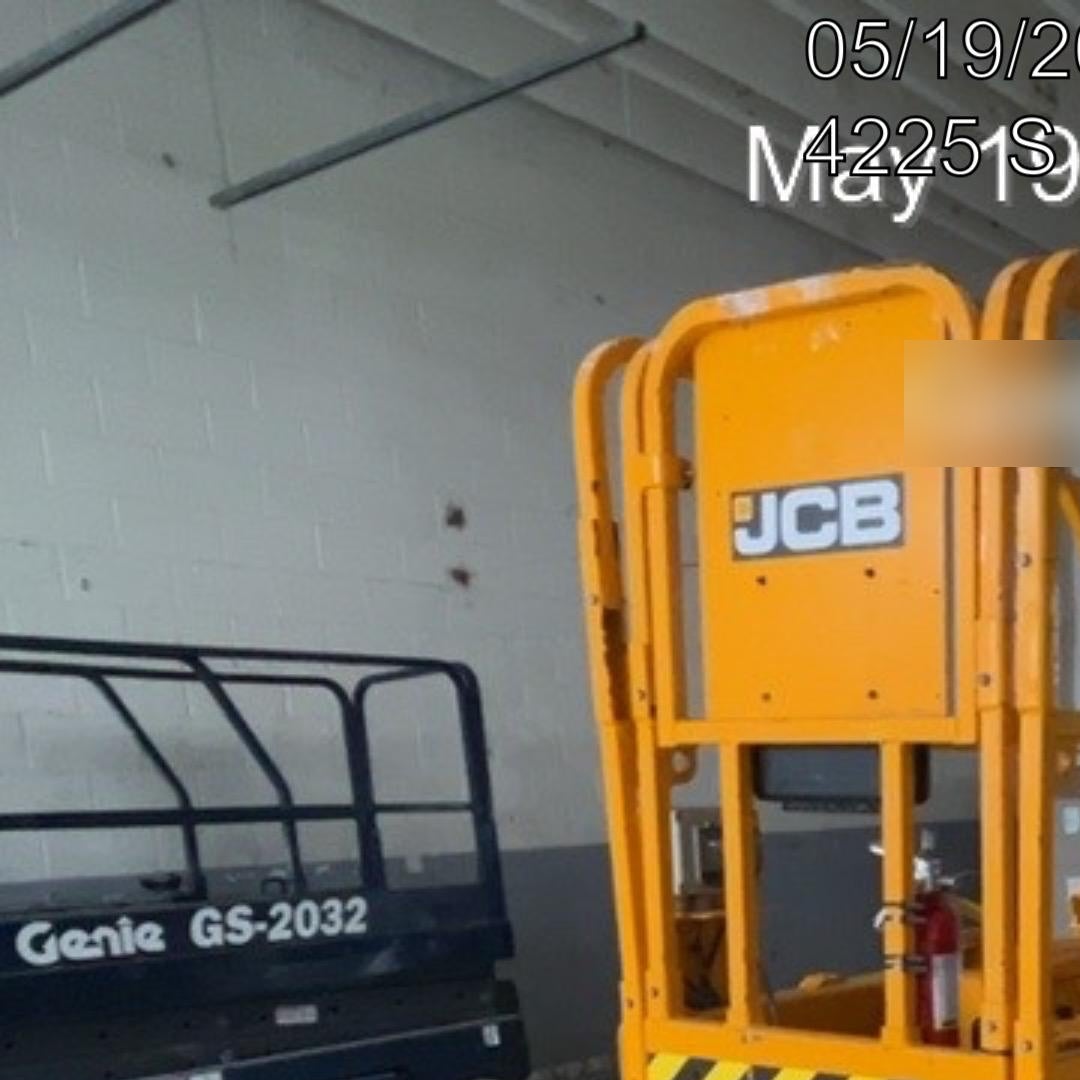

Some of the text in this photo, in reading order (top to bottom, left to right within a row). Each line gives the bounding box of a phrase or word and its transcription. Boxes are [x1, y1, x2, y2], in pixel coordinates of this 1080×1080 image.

[734, 479, 901, 556] JCB
[15, 895, 368, 966] Genie GS-2032
